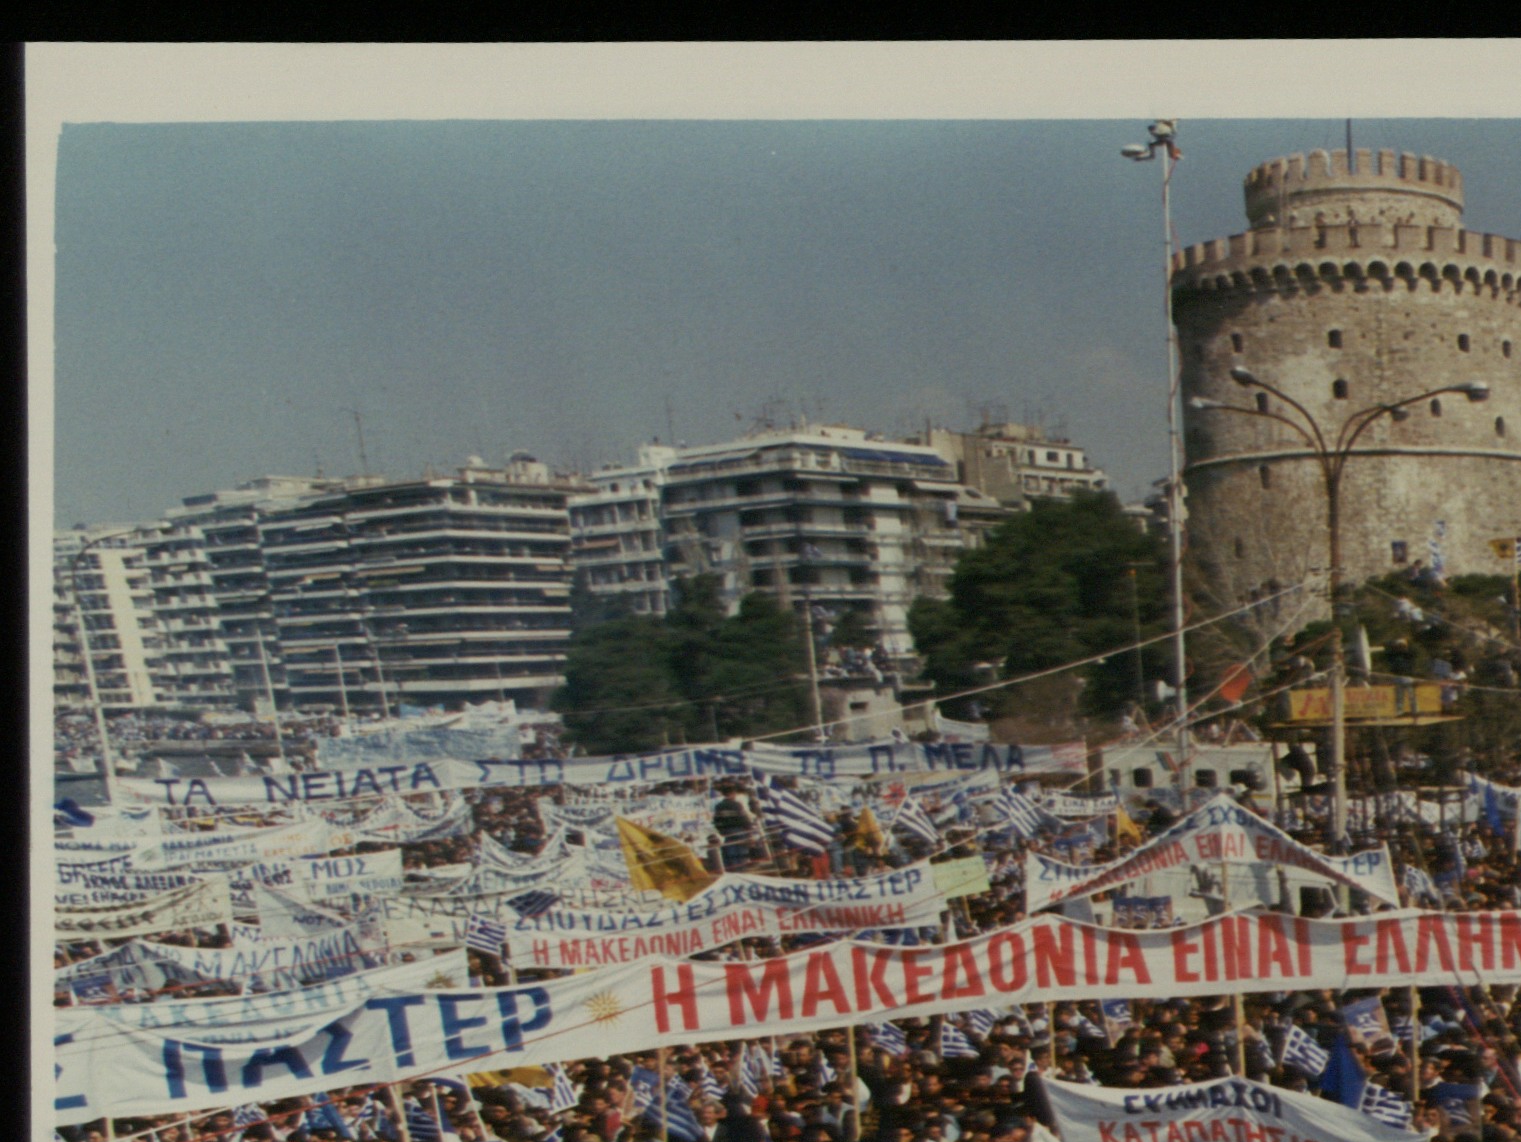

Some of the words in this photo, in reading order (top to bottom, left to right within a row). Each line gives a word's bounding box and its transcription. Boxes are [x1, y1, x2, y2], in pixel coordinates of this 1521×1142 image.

[154, 779, 216, 805] ΤΑ
[263, 762, 440, 802] ΝΕΙΑΤΑ
[926, 742, 1024, 771] ΜΕΛΑ
[532, 938, 549, 966] Η
[559, 927, 704, 966] ΜΑΚΕΔΟΝΙΑ
[712, 913, 766, 945] ΕΙΝΑΙ
[161, 985, 554, 1101] ΠΑΣΤΕΡ
[652, 962, 700, 1034] Η
[724, 922, 1151, 1026] ΜΑΚΕΔΟΝΙΑ
[1172, 914, 1312, 983] ΕΙΝΑΙ
